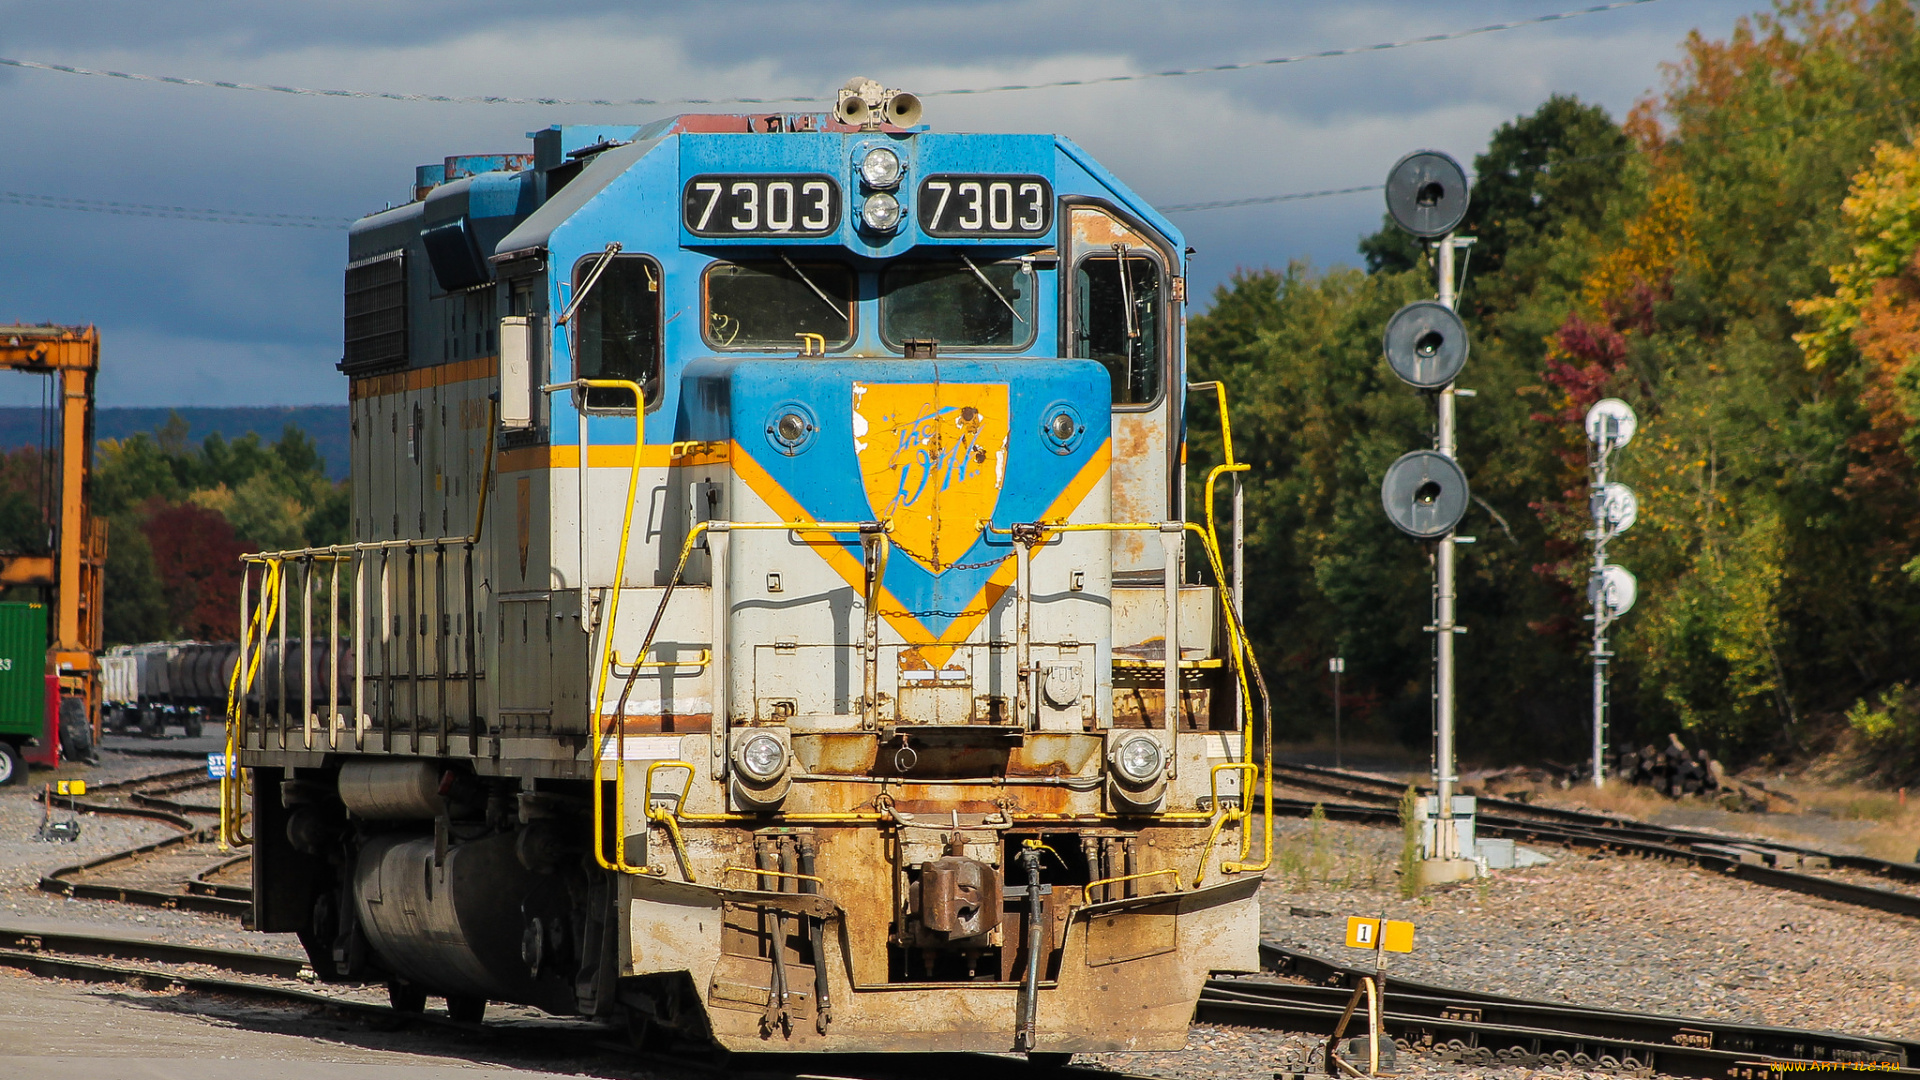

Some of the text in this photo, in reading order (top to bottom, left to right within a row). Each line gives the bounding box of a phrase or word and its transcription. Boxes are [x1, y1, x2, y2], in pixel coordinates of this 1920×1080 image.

[695, 182, 830, 231] 7303
[928, 182, 1043, 230] 7303
[1360, 926, 1368, 942] 1
